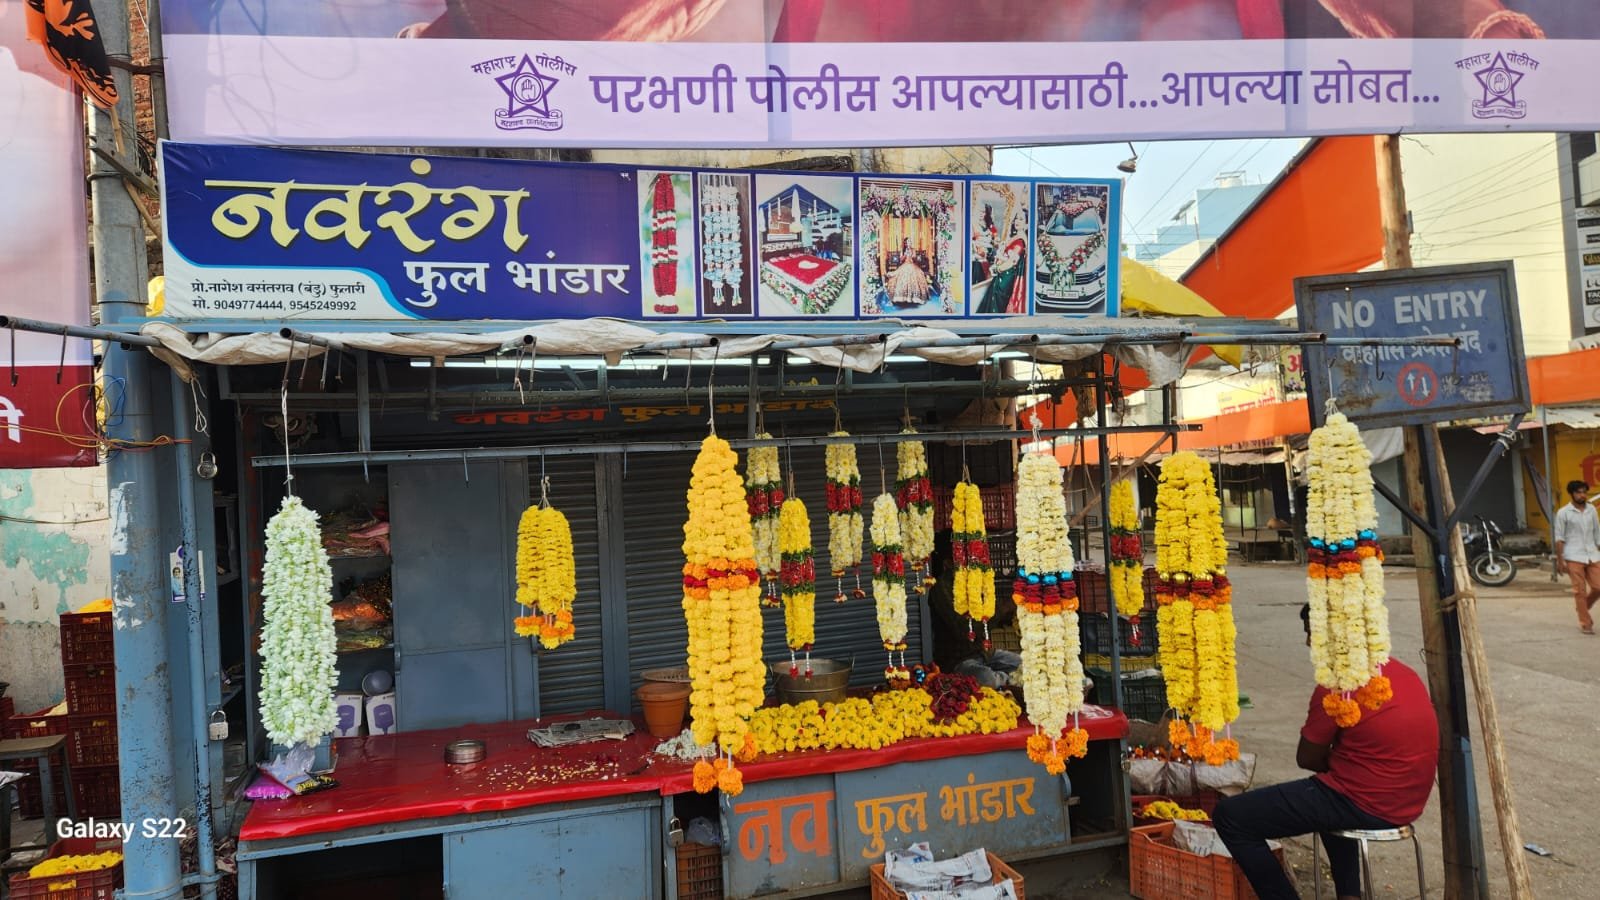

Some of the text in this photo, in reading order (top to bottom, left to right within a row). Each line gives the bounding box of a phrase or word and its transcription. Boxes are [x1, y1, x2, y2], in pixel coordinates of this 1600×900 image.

[471, 52, 577, 76] महाराष्ट्र पोलीस
[1506, 50, 1540, 71] पोलीस
[589, 63, 737, 114] परभणी
[747, 64, 880, 114] पोलीस
[204, 158, 530, 253] नवरंग
[246, 280, 294, 294] वसंतराव
[403, 250, 630, 308] फुल भांडार
[192, 296, 356, 312] मो. 9049774444, 9545249992
[1332, 288, 1488, 330] NO ENTRY
[454, 405, 609, 425] नवरंग
[733, 772, 1036, 865] नव फुल भांडार
